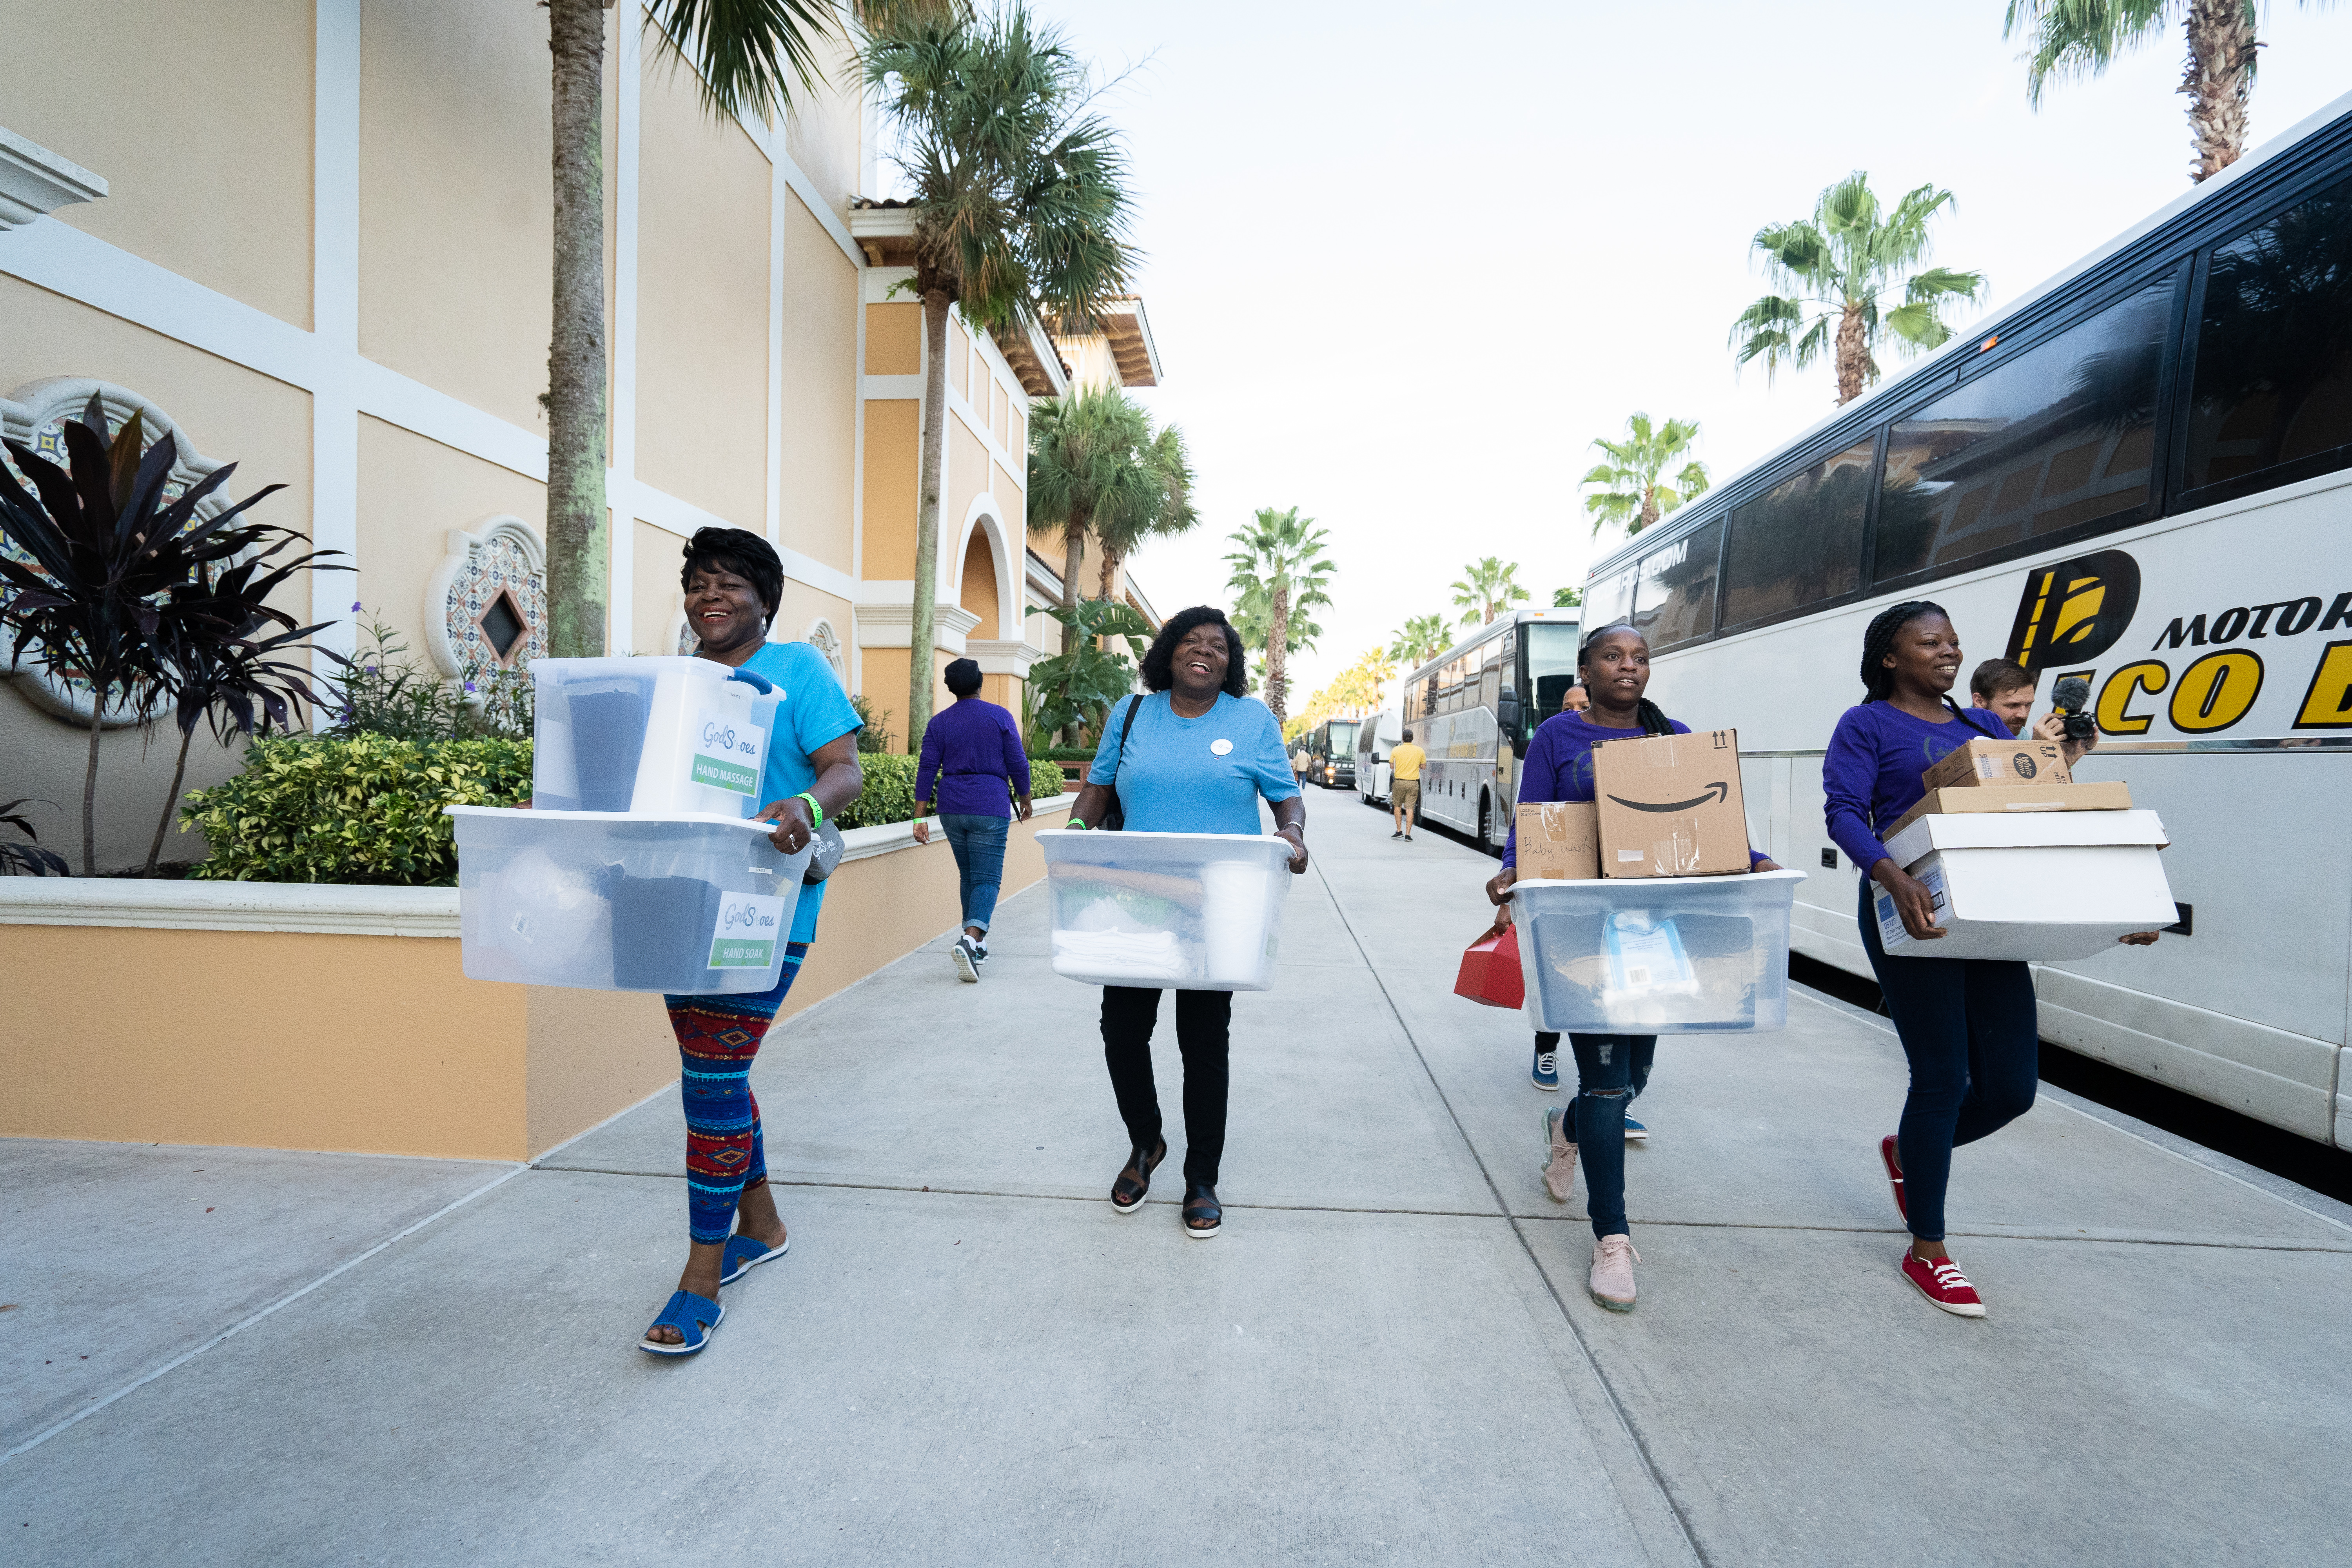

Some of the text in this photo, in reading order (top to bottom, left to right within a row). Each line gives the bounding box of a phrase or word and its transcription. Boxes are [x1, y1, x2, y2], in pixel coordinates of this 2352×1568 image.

[2040, 746, 2047, 757] UP
[2015, 757, 2025, 774] Rain
[2021, 756, 2032, 776] White
[696, 763, 753, 787] HAND MASSAGE
[1524, 837, 1554, 861] Baby
[1884, 918, 1896, 930] 05127
[723, 948, 764, 959] HAND SOAK
